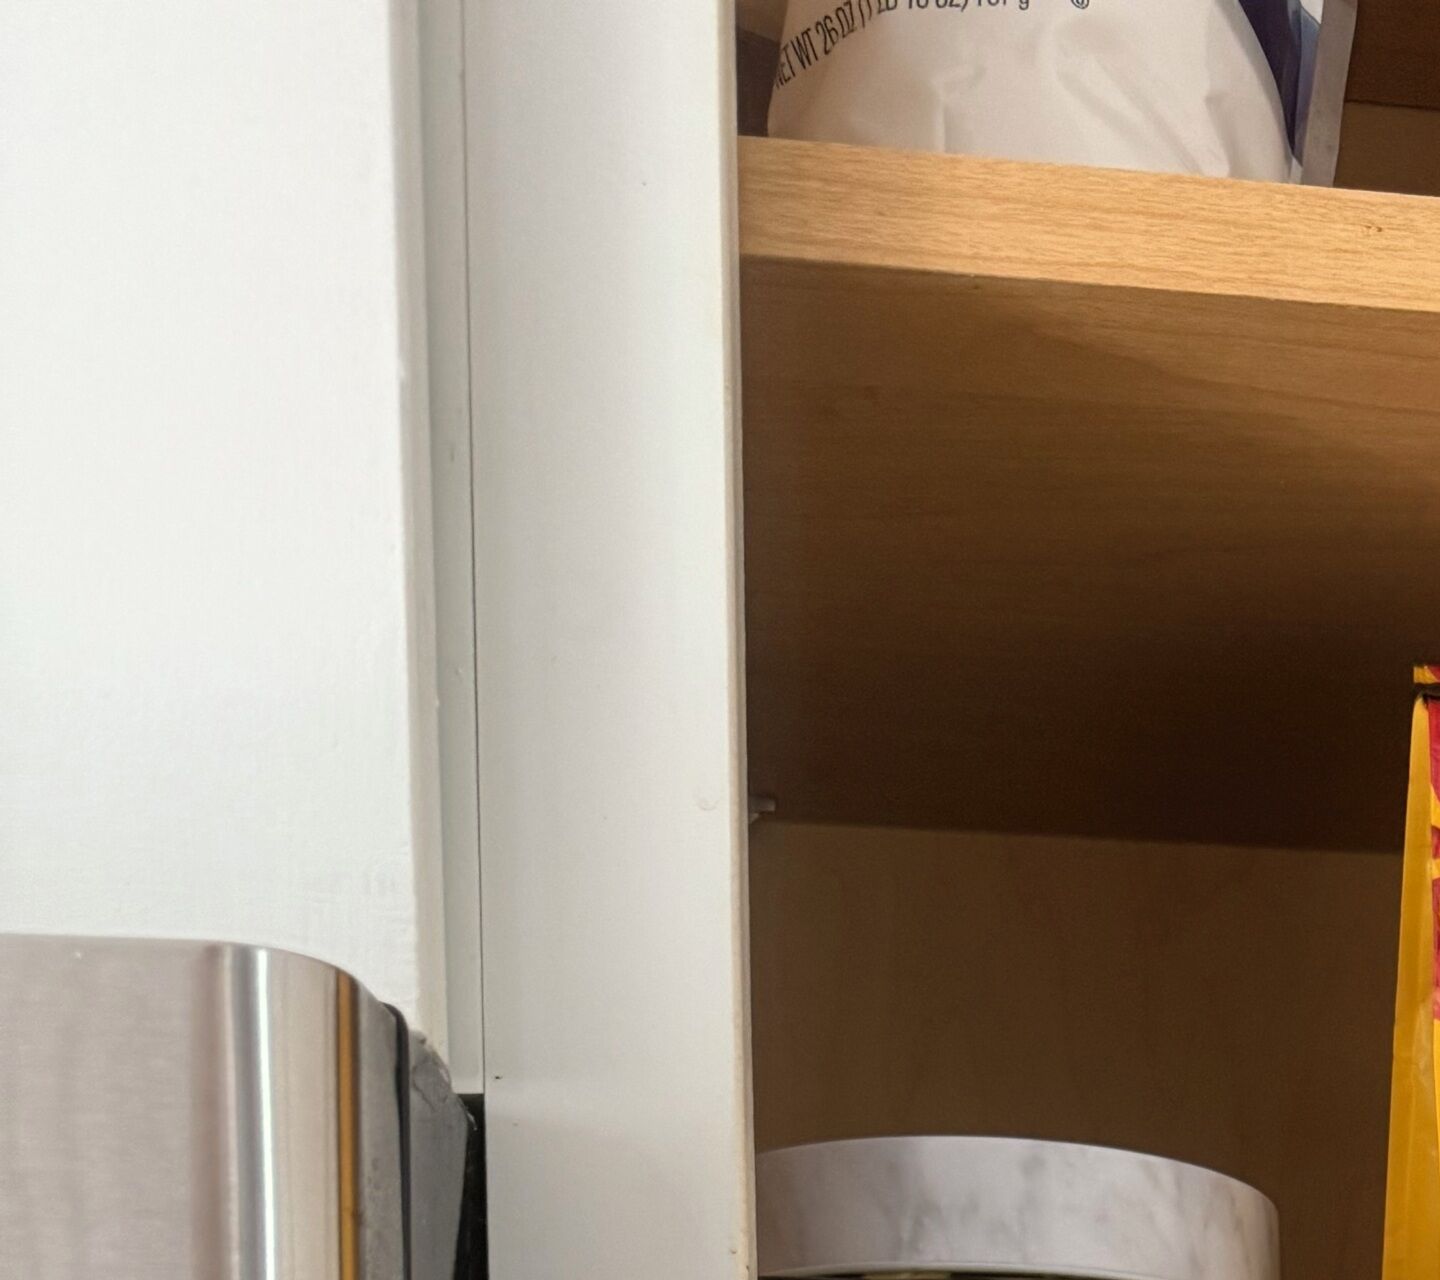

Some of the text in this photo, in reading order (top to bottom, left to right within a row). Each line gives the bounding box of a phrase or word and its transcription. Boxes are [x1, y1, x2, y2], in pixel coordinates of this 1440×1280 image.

[790, 27, 819, 70] WT
[815, 15, 839, 56] 26
[835, 0, 858, 38] OZ
